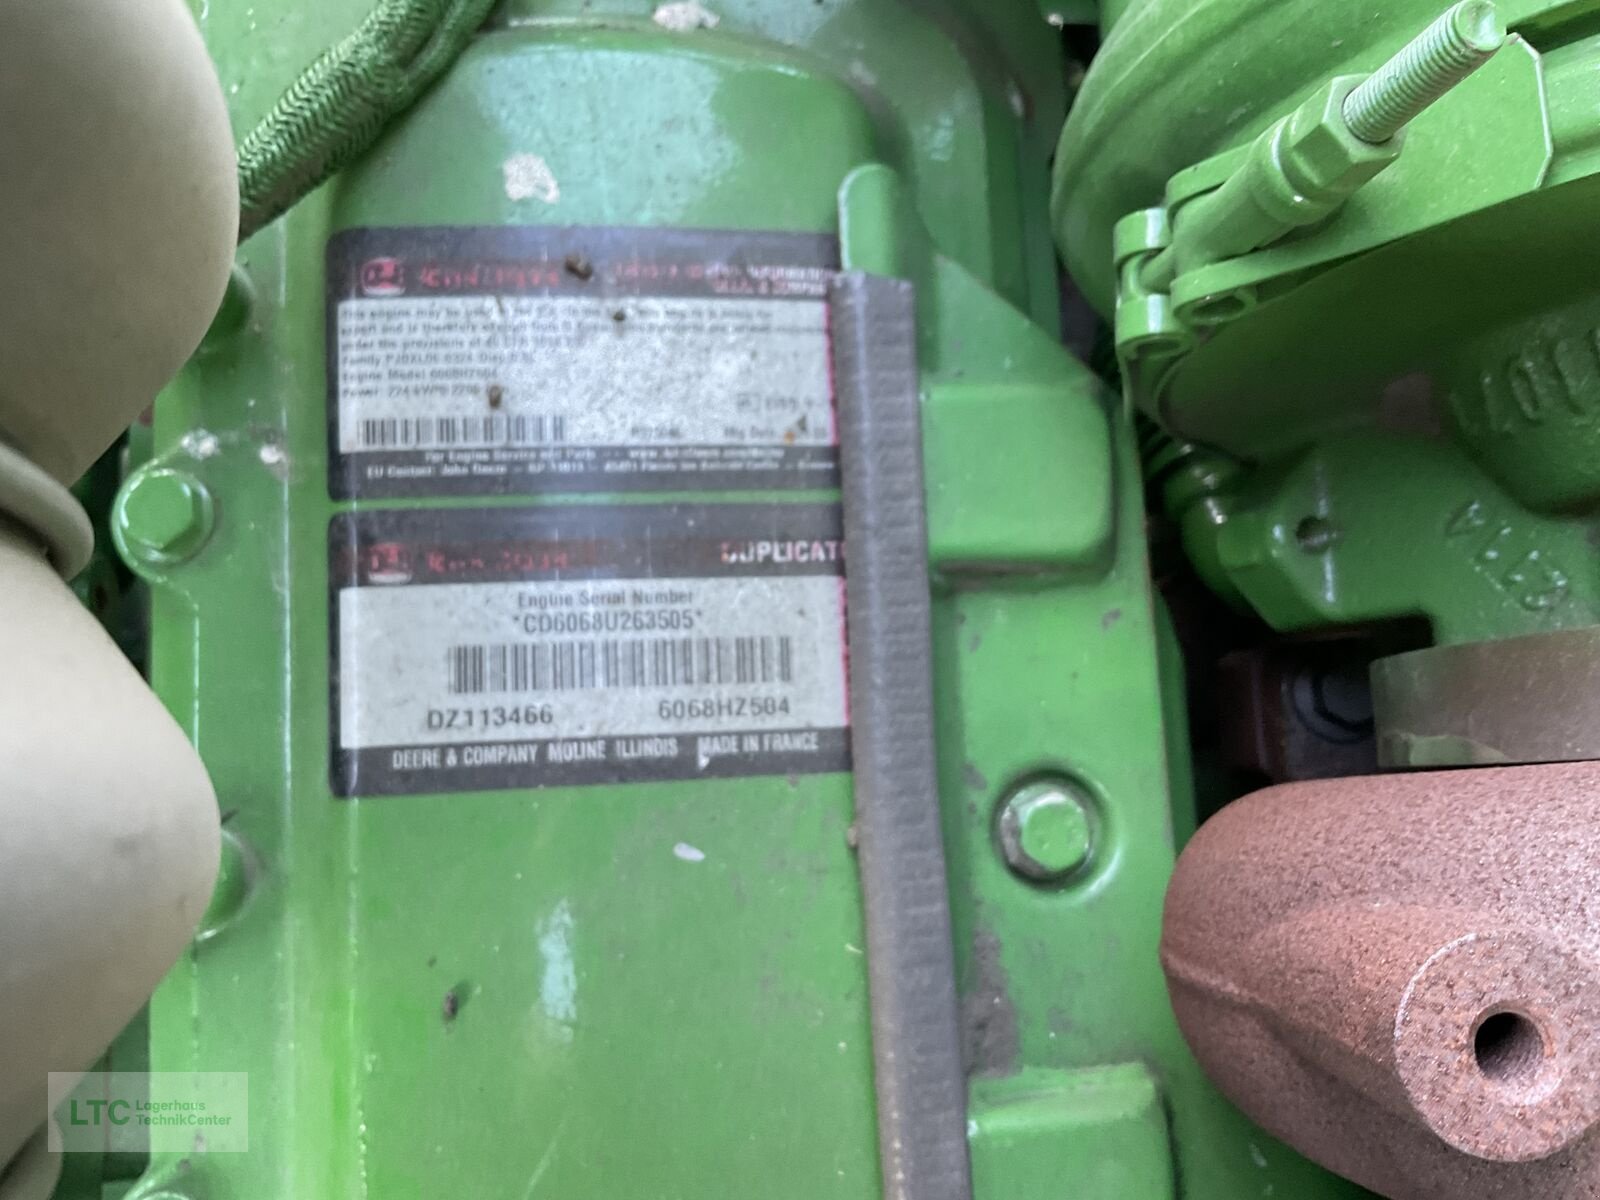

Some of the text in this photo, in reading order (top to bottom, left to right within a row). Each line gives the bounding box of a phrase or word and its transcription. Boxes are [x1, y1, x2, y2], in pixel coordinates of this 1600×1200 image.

[518, 591, 574, 609] Engine
[632, 589, 694, 606] Number
[427, 703, 554, 730] DZ113466
[657, 696, 791, 721] 6068HZ504
[392, 749, 442, 770] DEERE
[463, 743, 540, 767] COMPANY
[547, 738, 607, 763] MOLINE
[615, 736, 679, 760] ILLINOIS
[696, 735, 739, 758] MADE
[741, 733, 760, 753] IN
[763, 731, 820, 752] FRANCE
